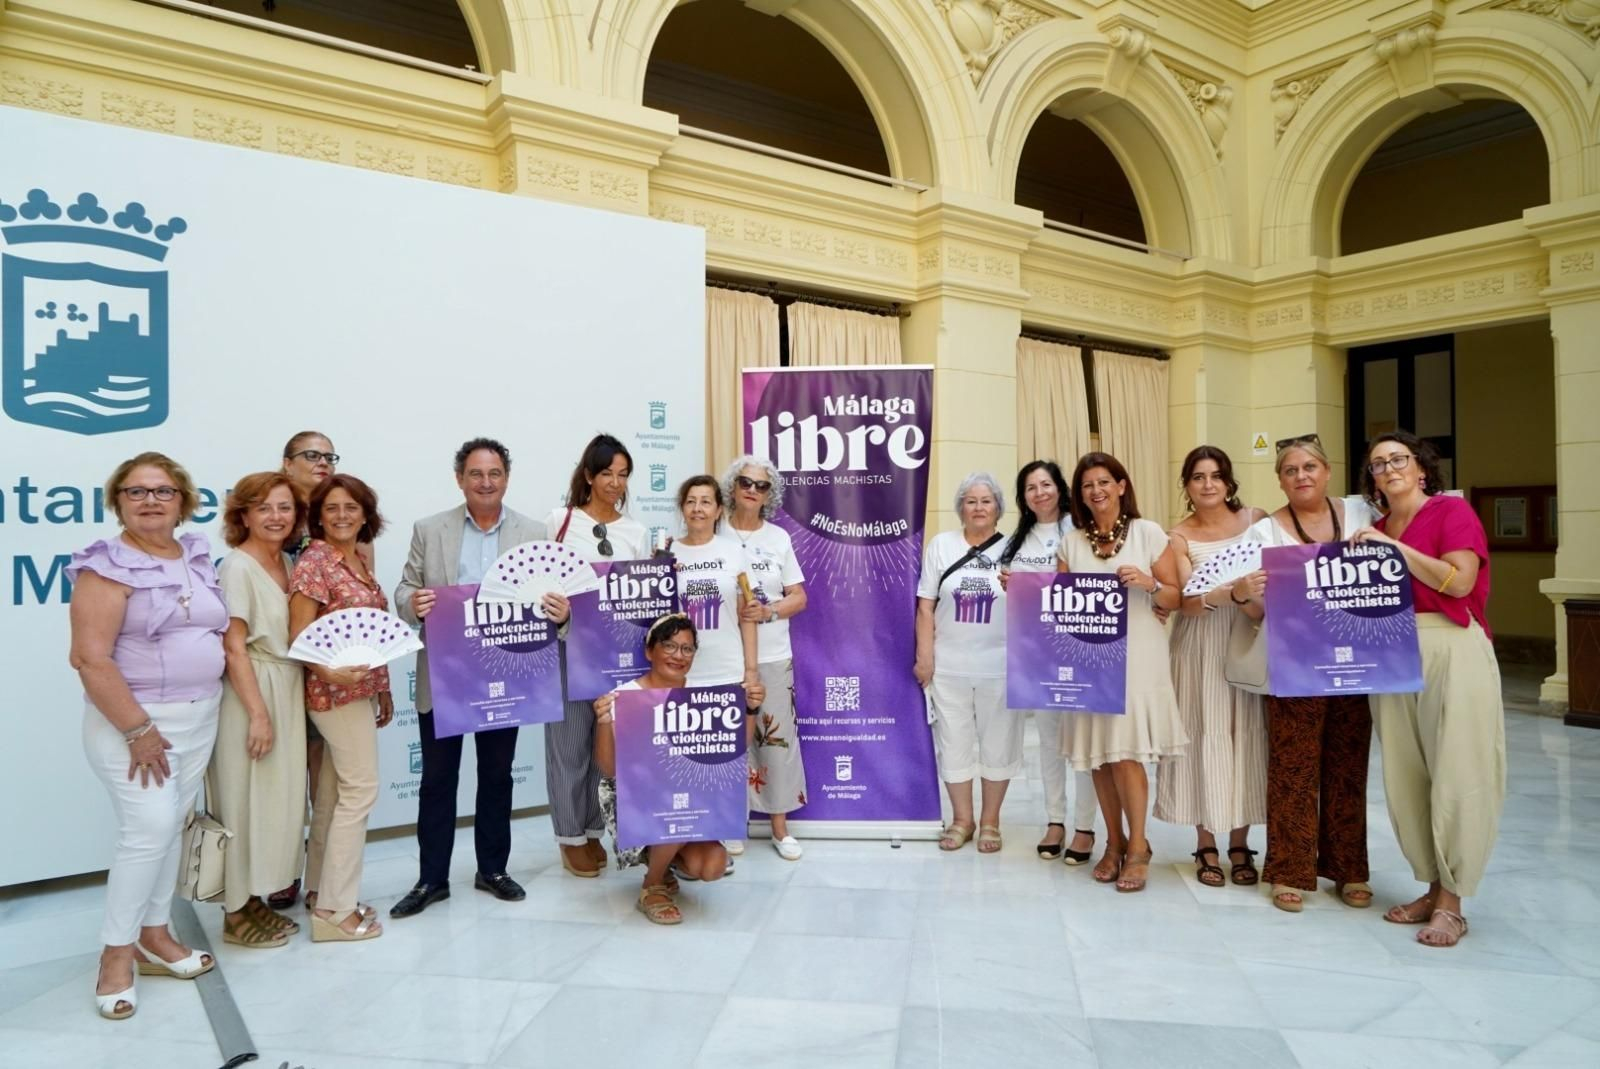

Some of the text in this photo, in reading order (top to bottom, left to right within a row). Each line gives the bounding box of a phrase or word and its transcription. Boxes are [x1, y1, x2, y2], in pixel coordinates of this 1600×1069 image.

[823, 394, 916, 424] Málaga
[641, 441, 650, 449] de
[748, 411, 928, 472] libre
[779, 475, 892, 486] OLENCIAS MACHISTAS
[810, 512, 909, 539] #NoEsNoMálaga
[1343, 544, 1394, 560] Málaga
[630, 564, 671, 577] Málaga
[1304, 555, 1405, 589] libre
[597, 572, 676, 601] libre
[1075, 577, 1119, 592] Málaga
[1306, 583, 1400, 600] de violencias
[598, 598, 672, 612] de violencias
[1041, 584, 1125, 613] libre
[1325, 595, 1401, 610] machistas
[1040, 612, 1119, 625] de violencias
[464, 621, 548, 638] de violencias
[1055, 623, 1118, 635] machistas
[481, 631, 548, 647] machistas
[691, 691, 736, 707] Málaga
[653, 701, 743, 733] libre
[819, 716, 833, 726] aquí
[653, 730, 736, 745] de violencias
[669, 743, 736, 756] machistas
[822, 784, 868, 793] Ayuntamiento
[837, 792, 862, 800] Málaga
